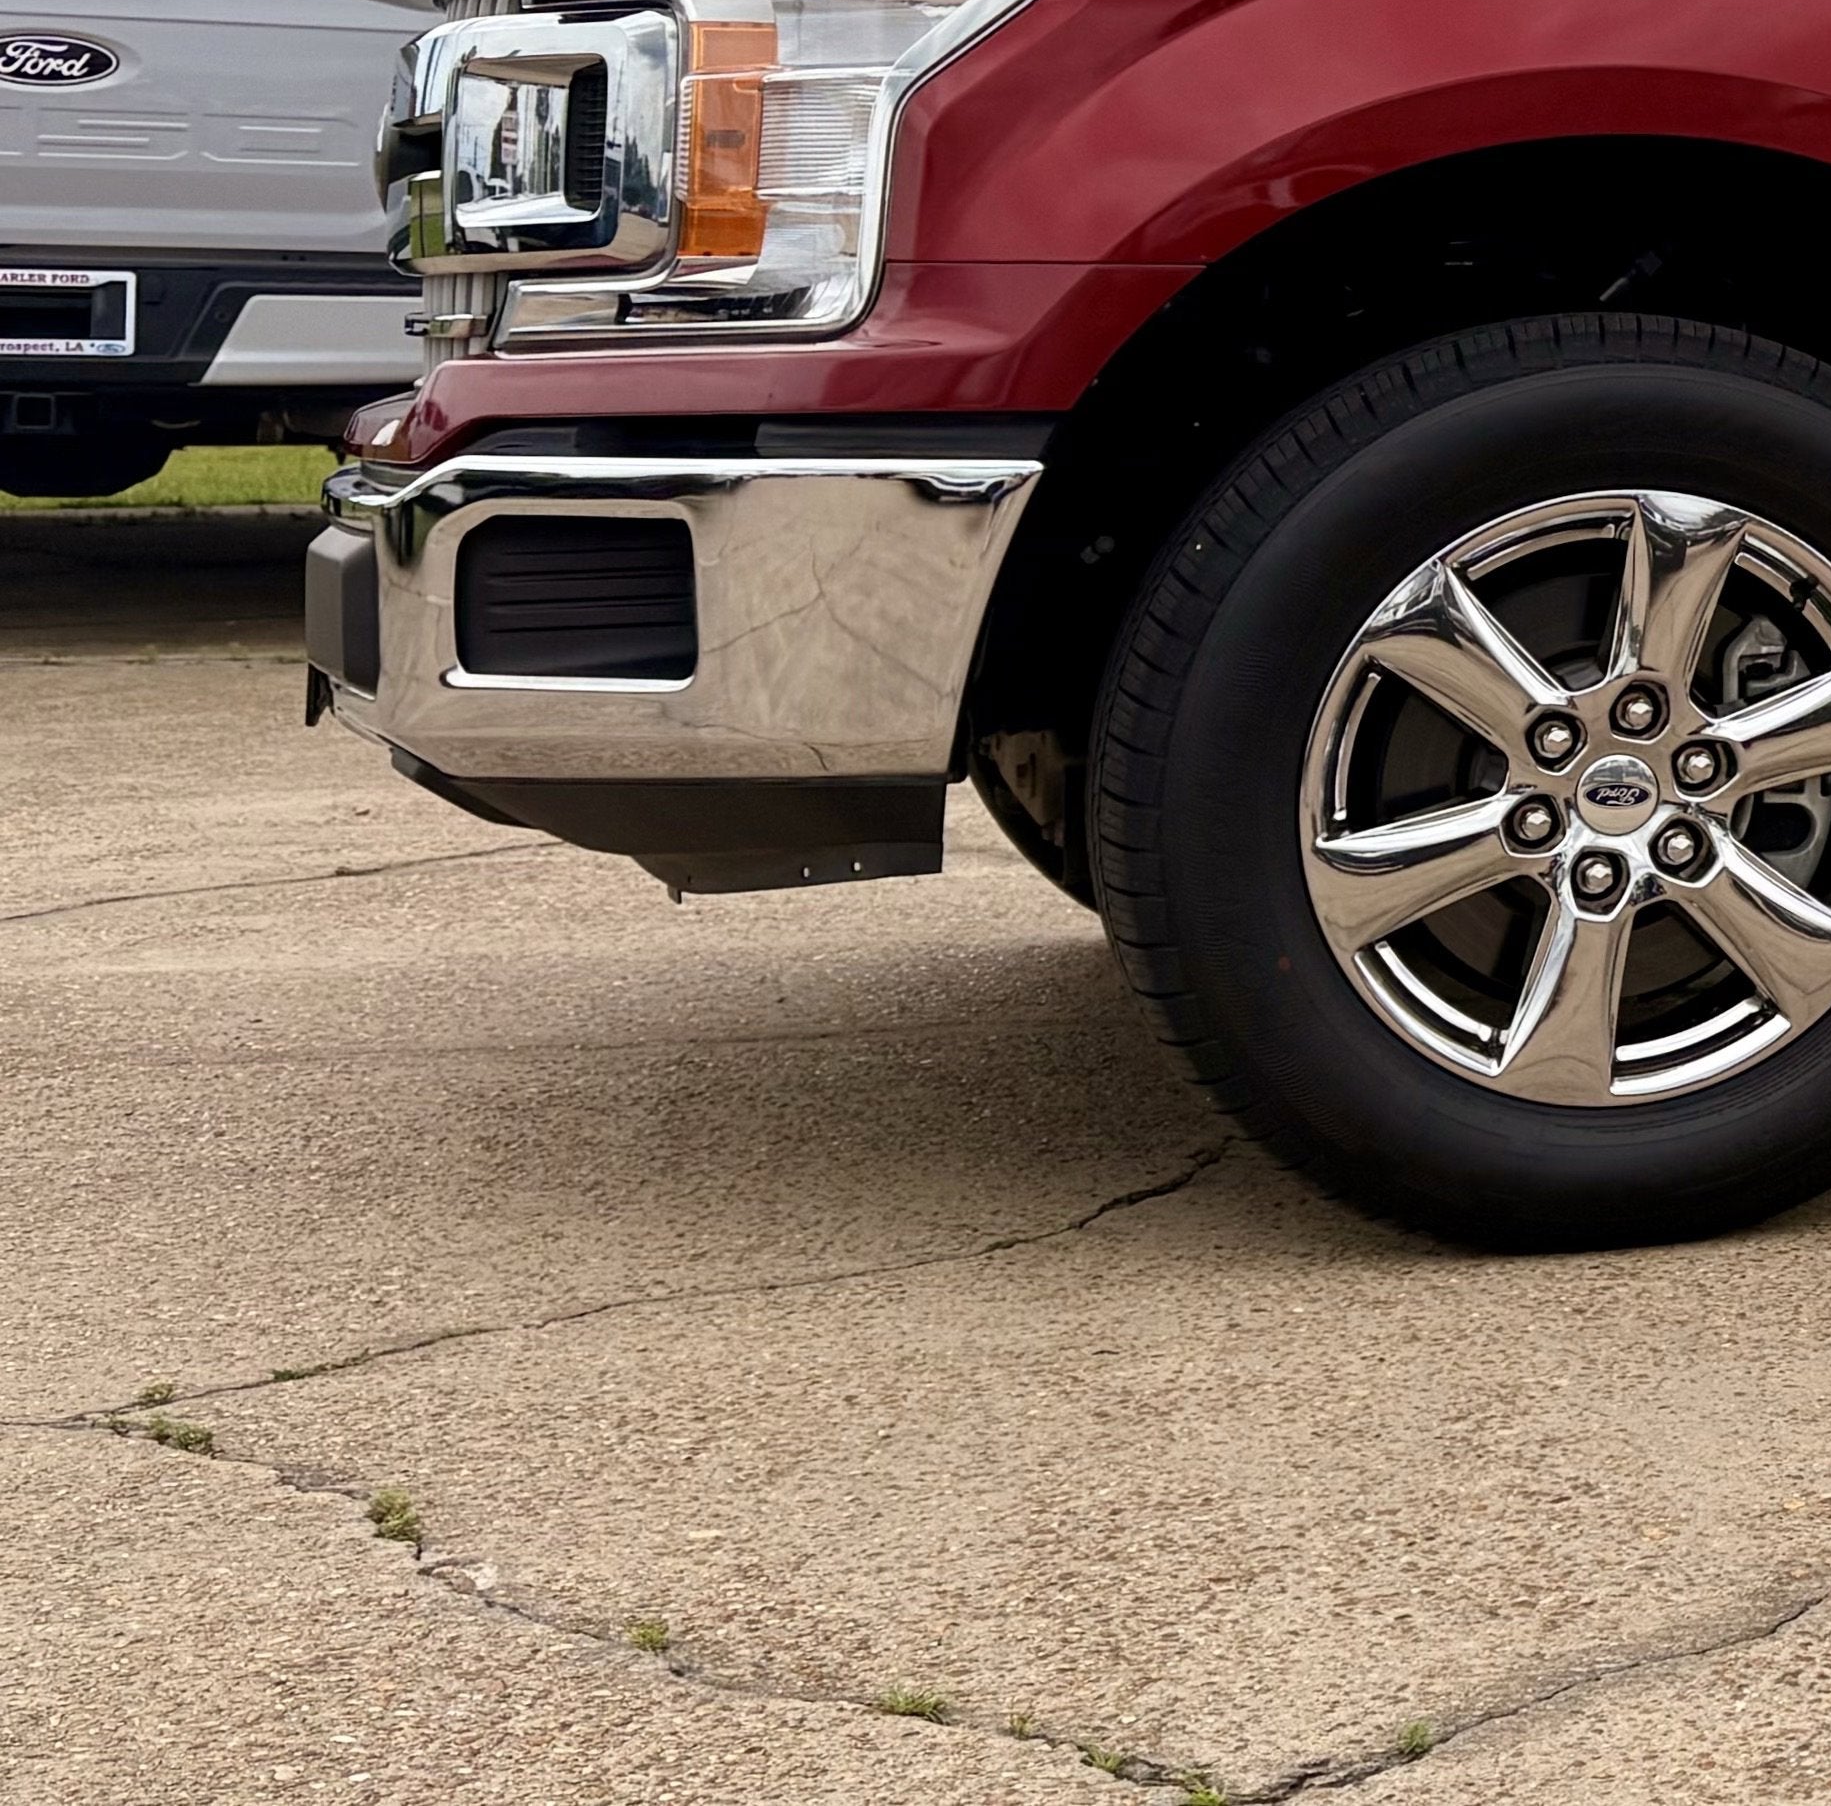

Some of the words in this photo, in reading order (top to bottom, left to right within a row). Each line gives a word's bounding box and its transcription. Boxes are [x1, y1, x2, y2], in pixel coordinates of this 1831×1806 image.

[0, 41, 91, 77] Ford
[51, 274, 90, 284] FORD
[65, 341, 84, 352] LA
[1595, 787, 1640, 806] Ford
